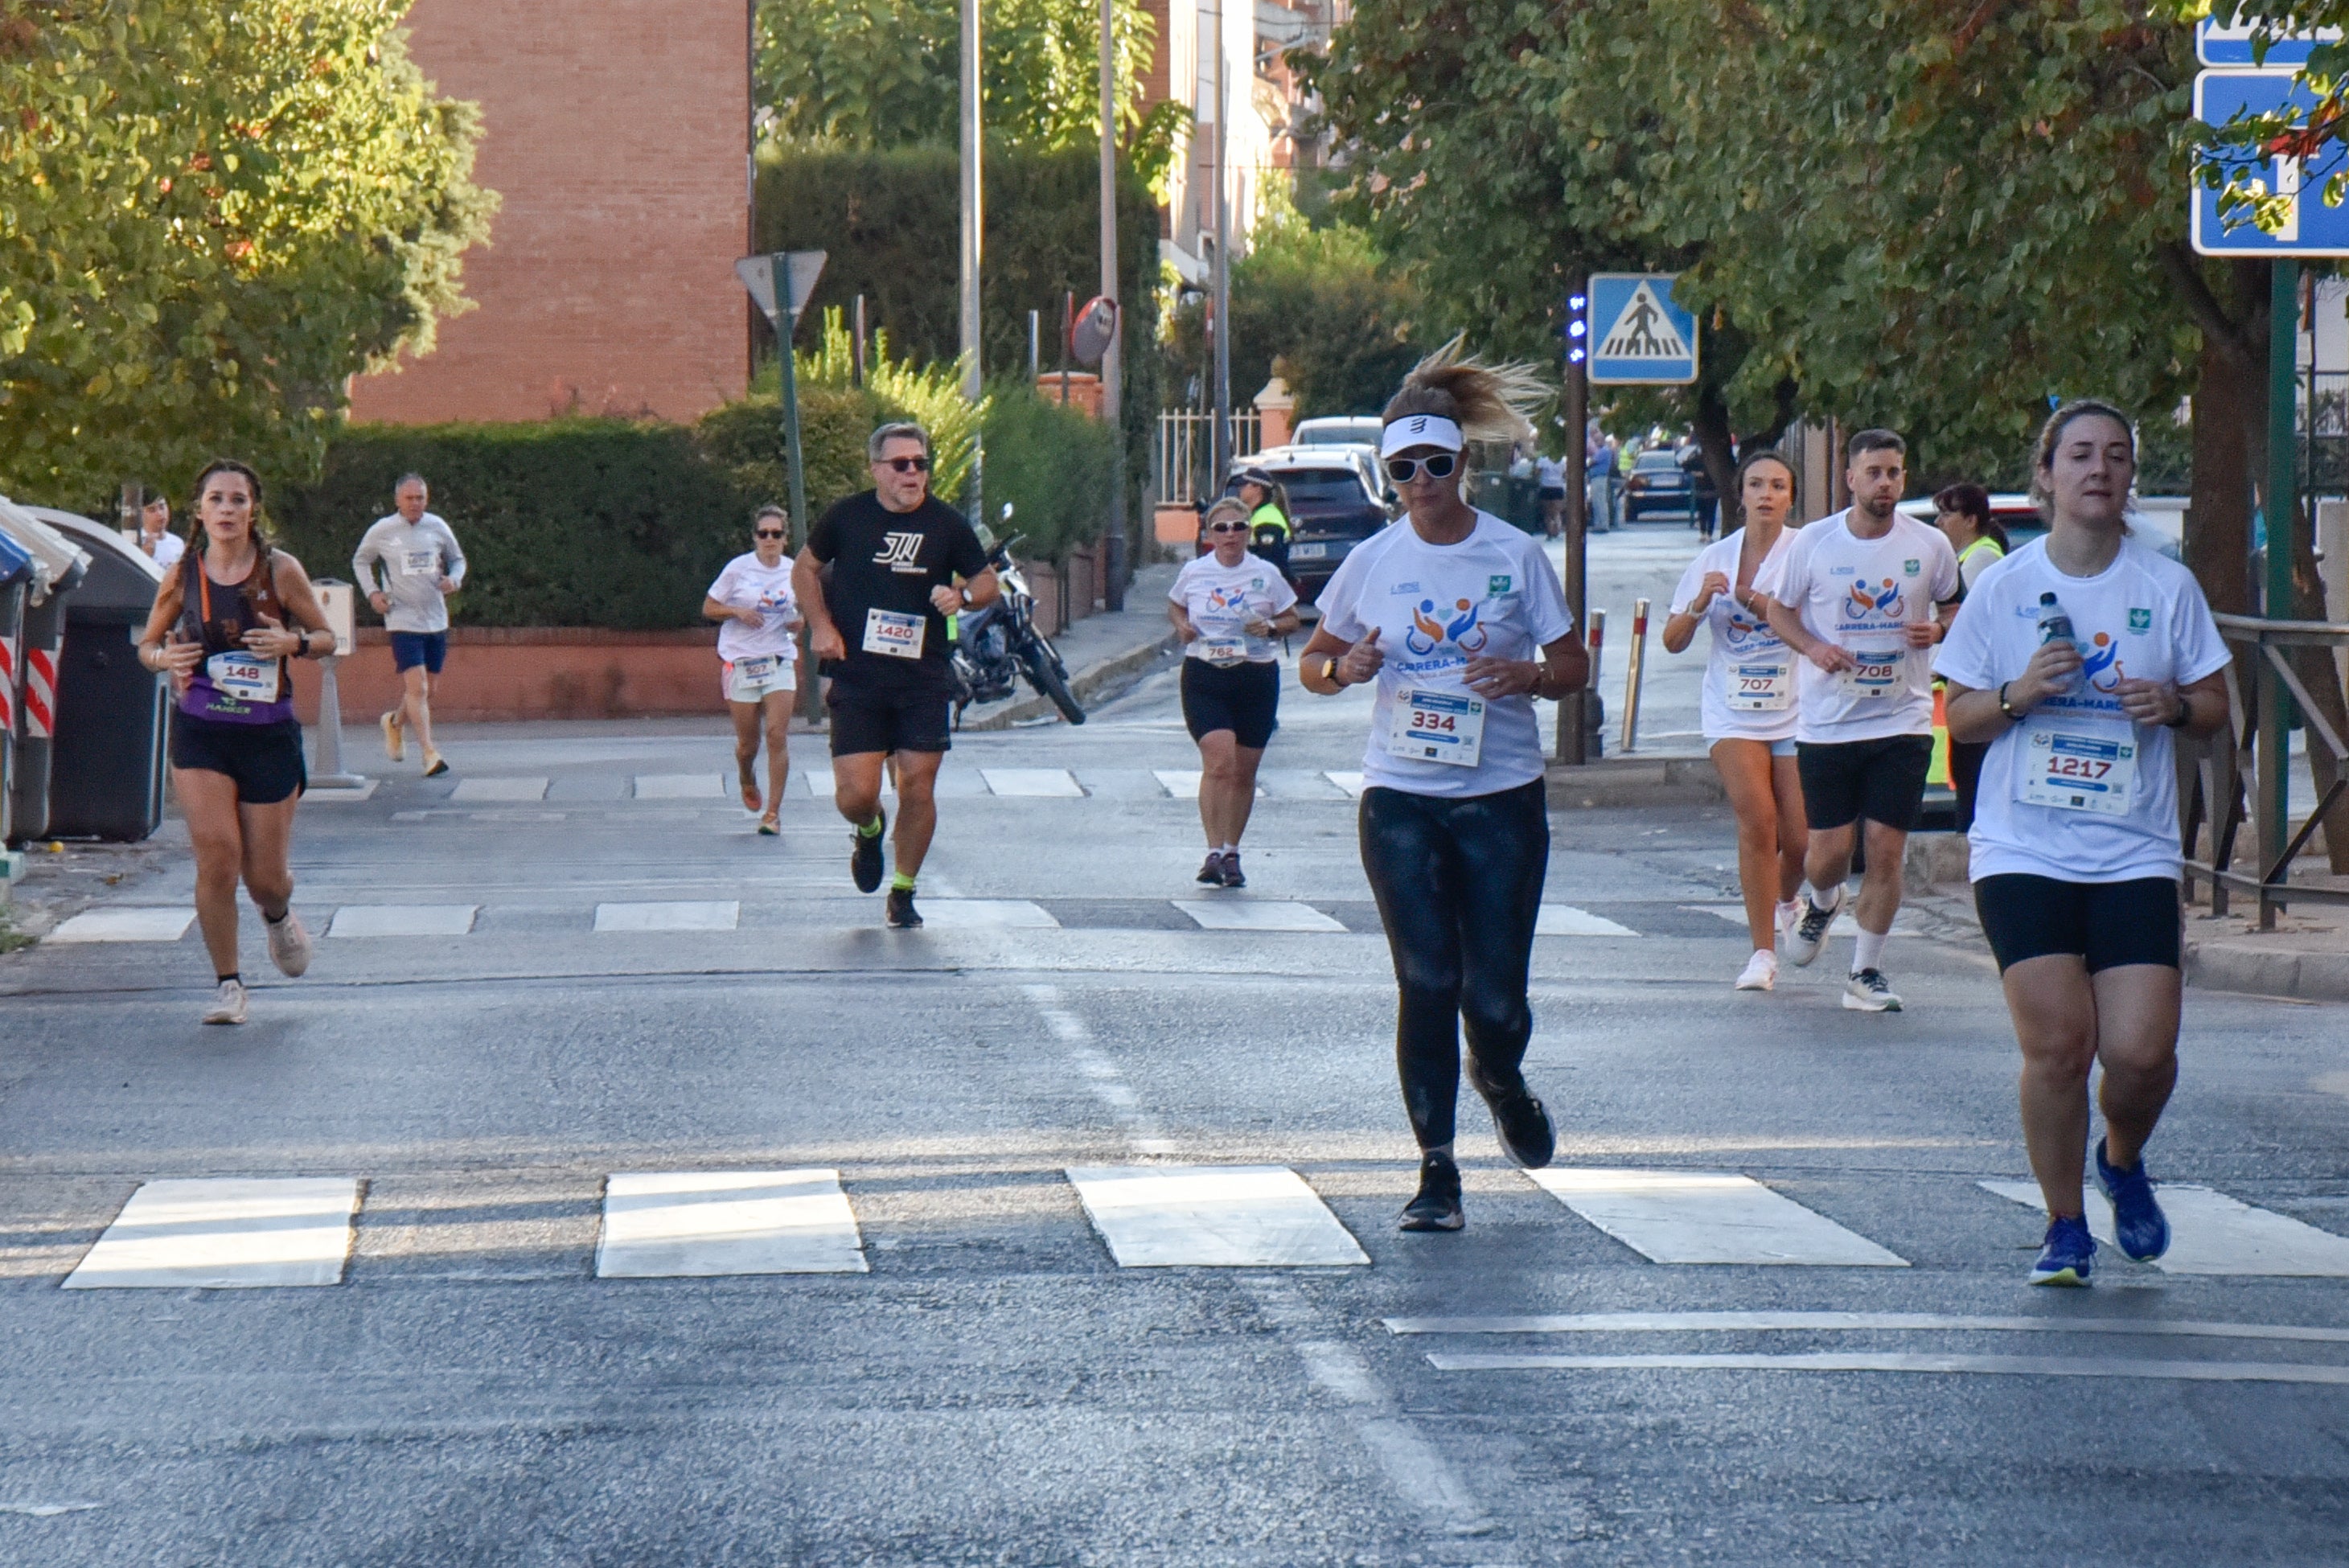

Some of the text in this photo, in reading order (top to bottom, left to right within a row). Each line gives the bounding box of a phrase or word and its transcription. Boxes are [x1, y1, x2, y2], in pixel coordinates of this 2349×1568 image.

[876, 624, 914, 639] 1420
[1209, 646, 1234, 657] 762
[226, 665, 260, 679] 148
[1856, 665, 1893, 677] 708
[1740, 679, 1773, 690] 707
[1411, 711, 1456, 732] 334
[2047, 756, 2112, 779] 1217
